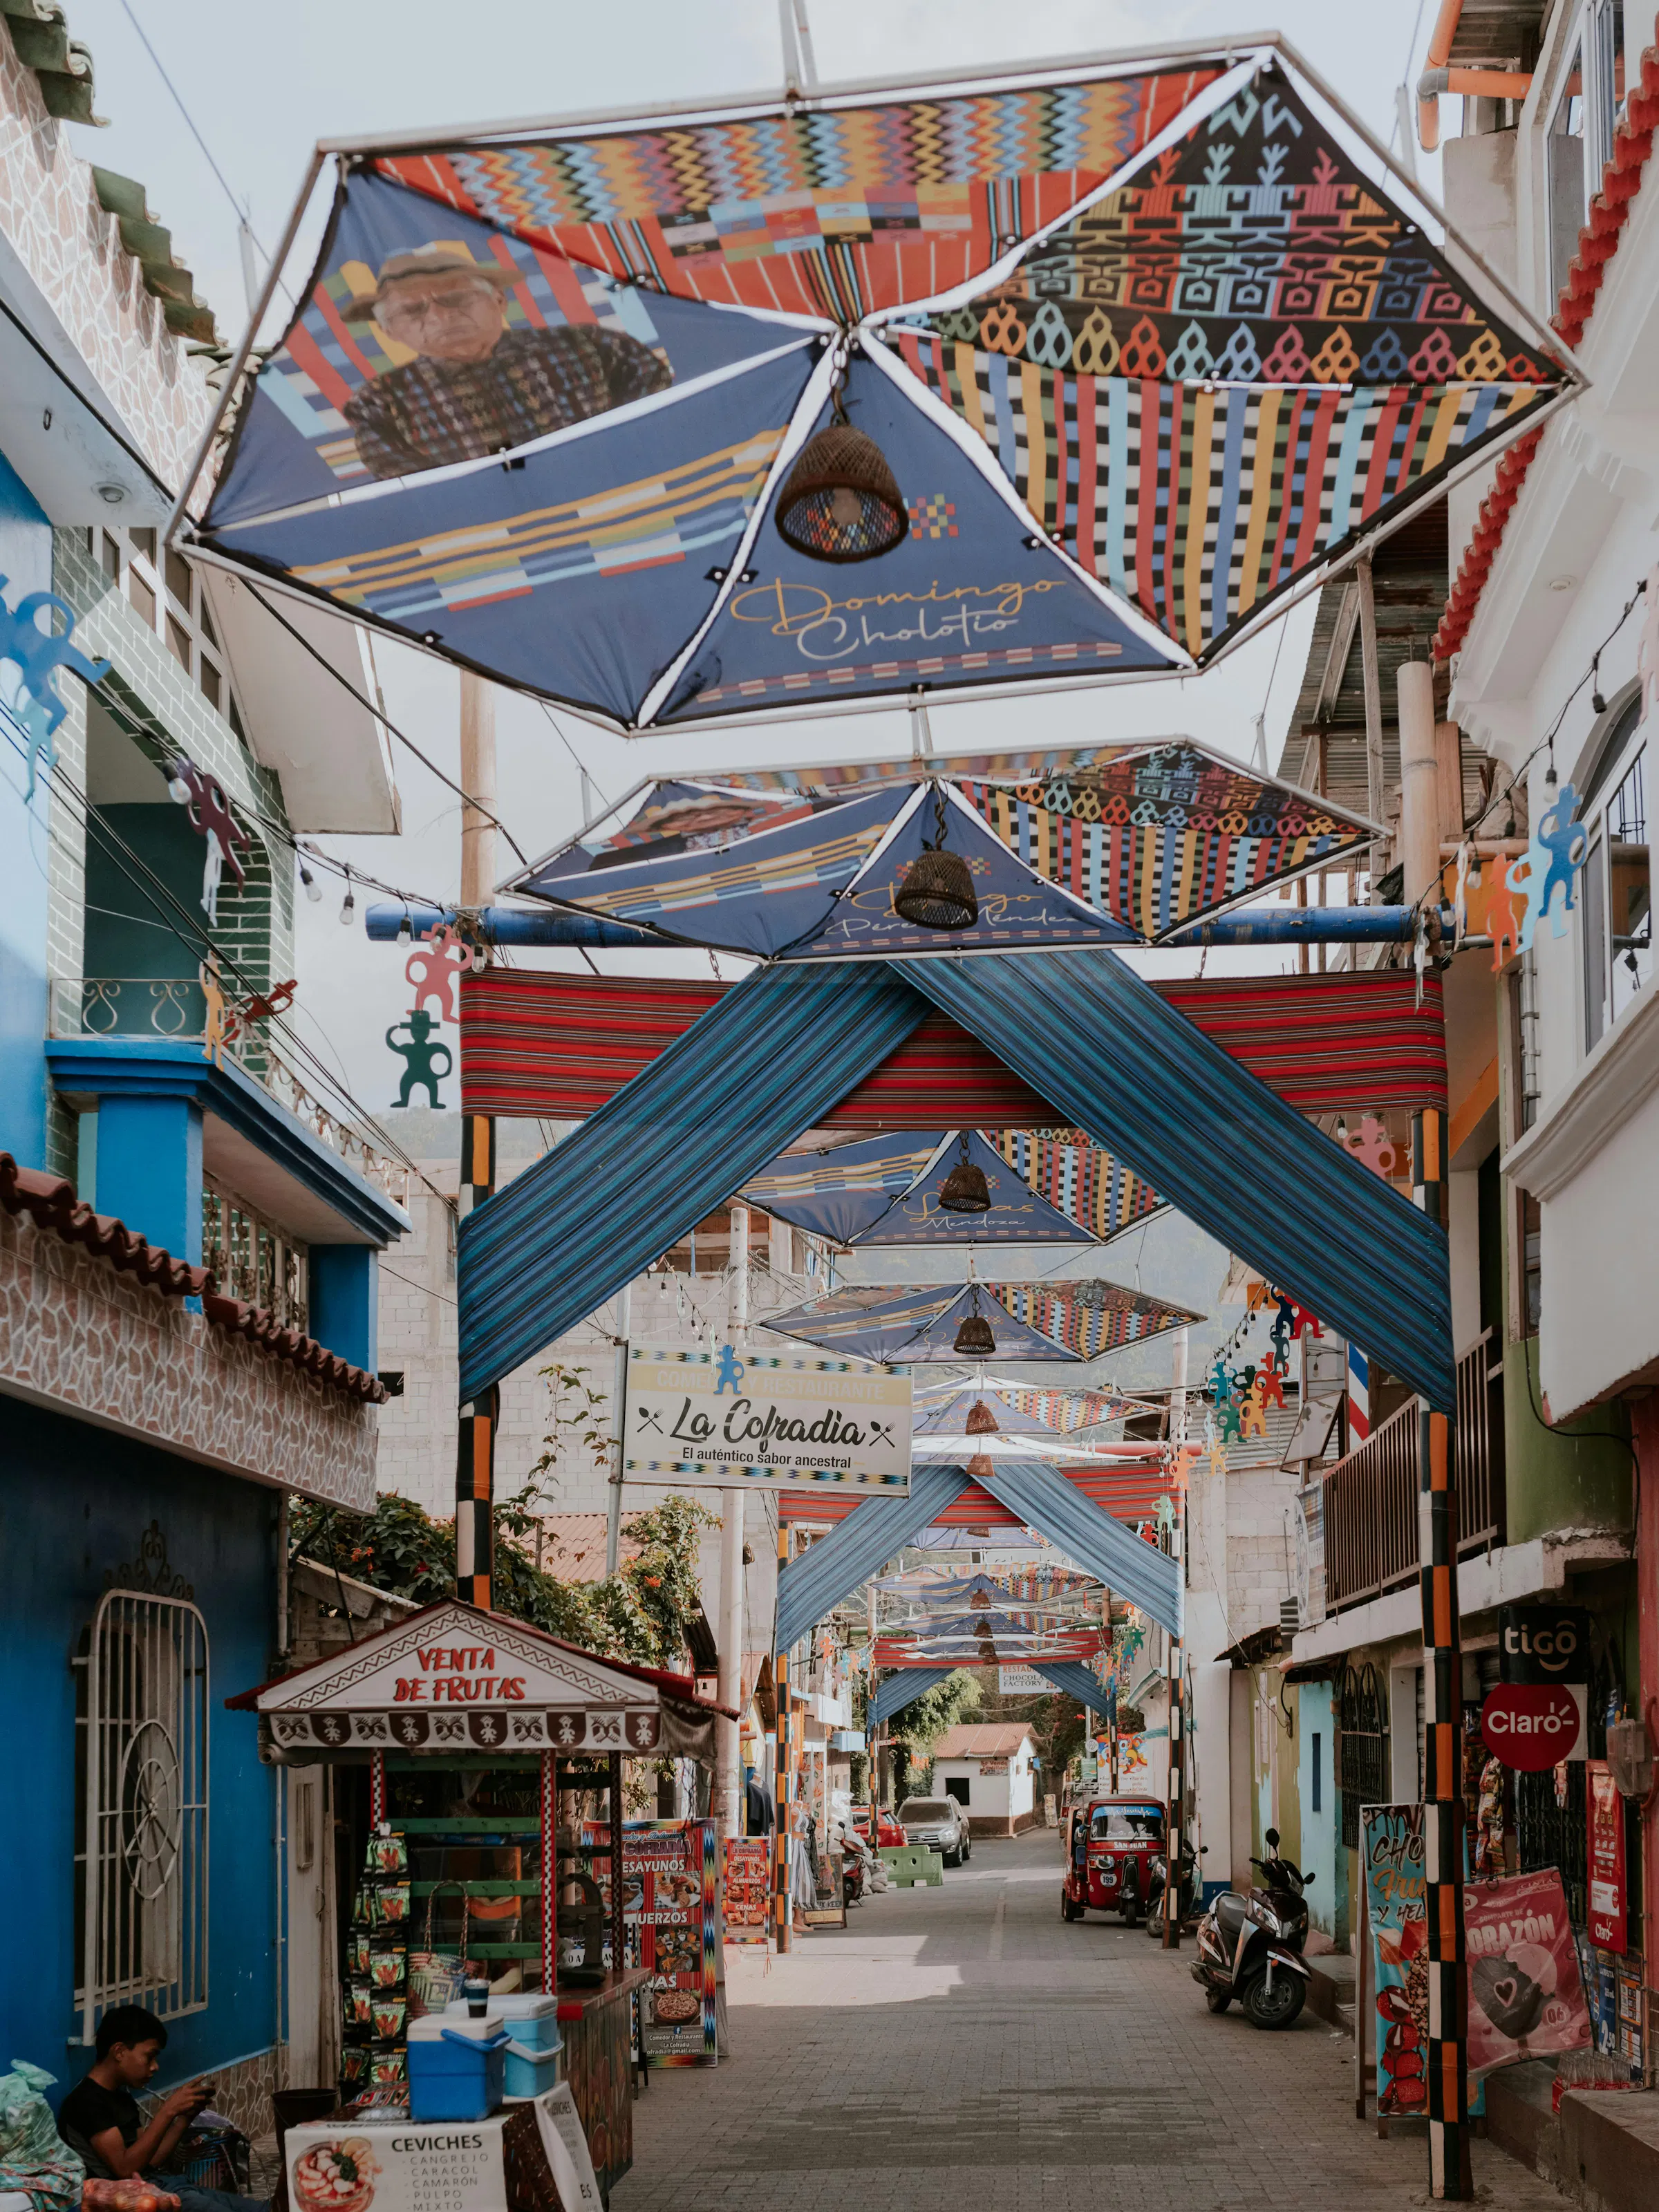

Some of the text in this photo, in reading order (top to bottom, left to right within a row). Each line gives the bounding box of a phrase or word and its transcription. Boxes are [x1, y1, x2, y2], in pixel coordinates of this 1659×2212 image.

[731, 578, 1067, 635] Domingo
[825, 918, 917, 938] Pere
[911, 1214, 1026, 1230] Mendoza
[763, 1378, 885, 1400] RESTAURANTE
[670, 1396, 716, 1444] La
[683, 1447, 851, 1469] El auténtico sabor ancestral
[417, 1647, 495, 1671] VENTA
[393, 1676, 527, 1702] DE FRUTAS
[1488, 1709, 1562, 1734] Claro
[1372, 1833, 1425, 1872] CHO
[622, 1859, 685, 1873] ESAYUNOS
[637, 1911, 688, 1924] UERZOS
[1377, 1903, 1426, 1925] Y HEL
[1465, 1909, 1555, 1955] ORAZÓN
[1595, 1922, 1611, 1941] Claro
[373, 2053, 403, 2063] TAQUERITOS
[391, 2134, 482, 2153] CEVICHES
[410, 2153, 489, 2165] CANGREJO
[411, 2165, 479, 2177] CARACOL
[412, 2176, 478, 2188] CAMARÓN
[414, 2190, 462, 2200] PULPO
[413, 2202, 462, 2211] MIXTO
